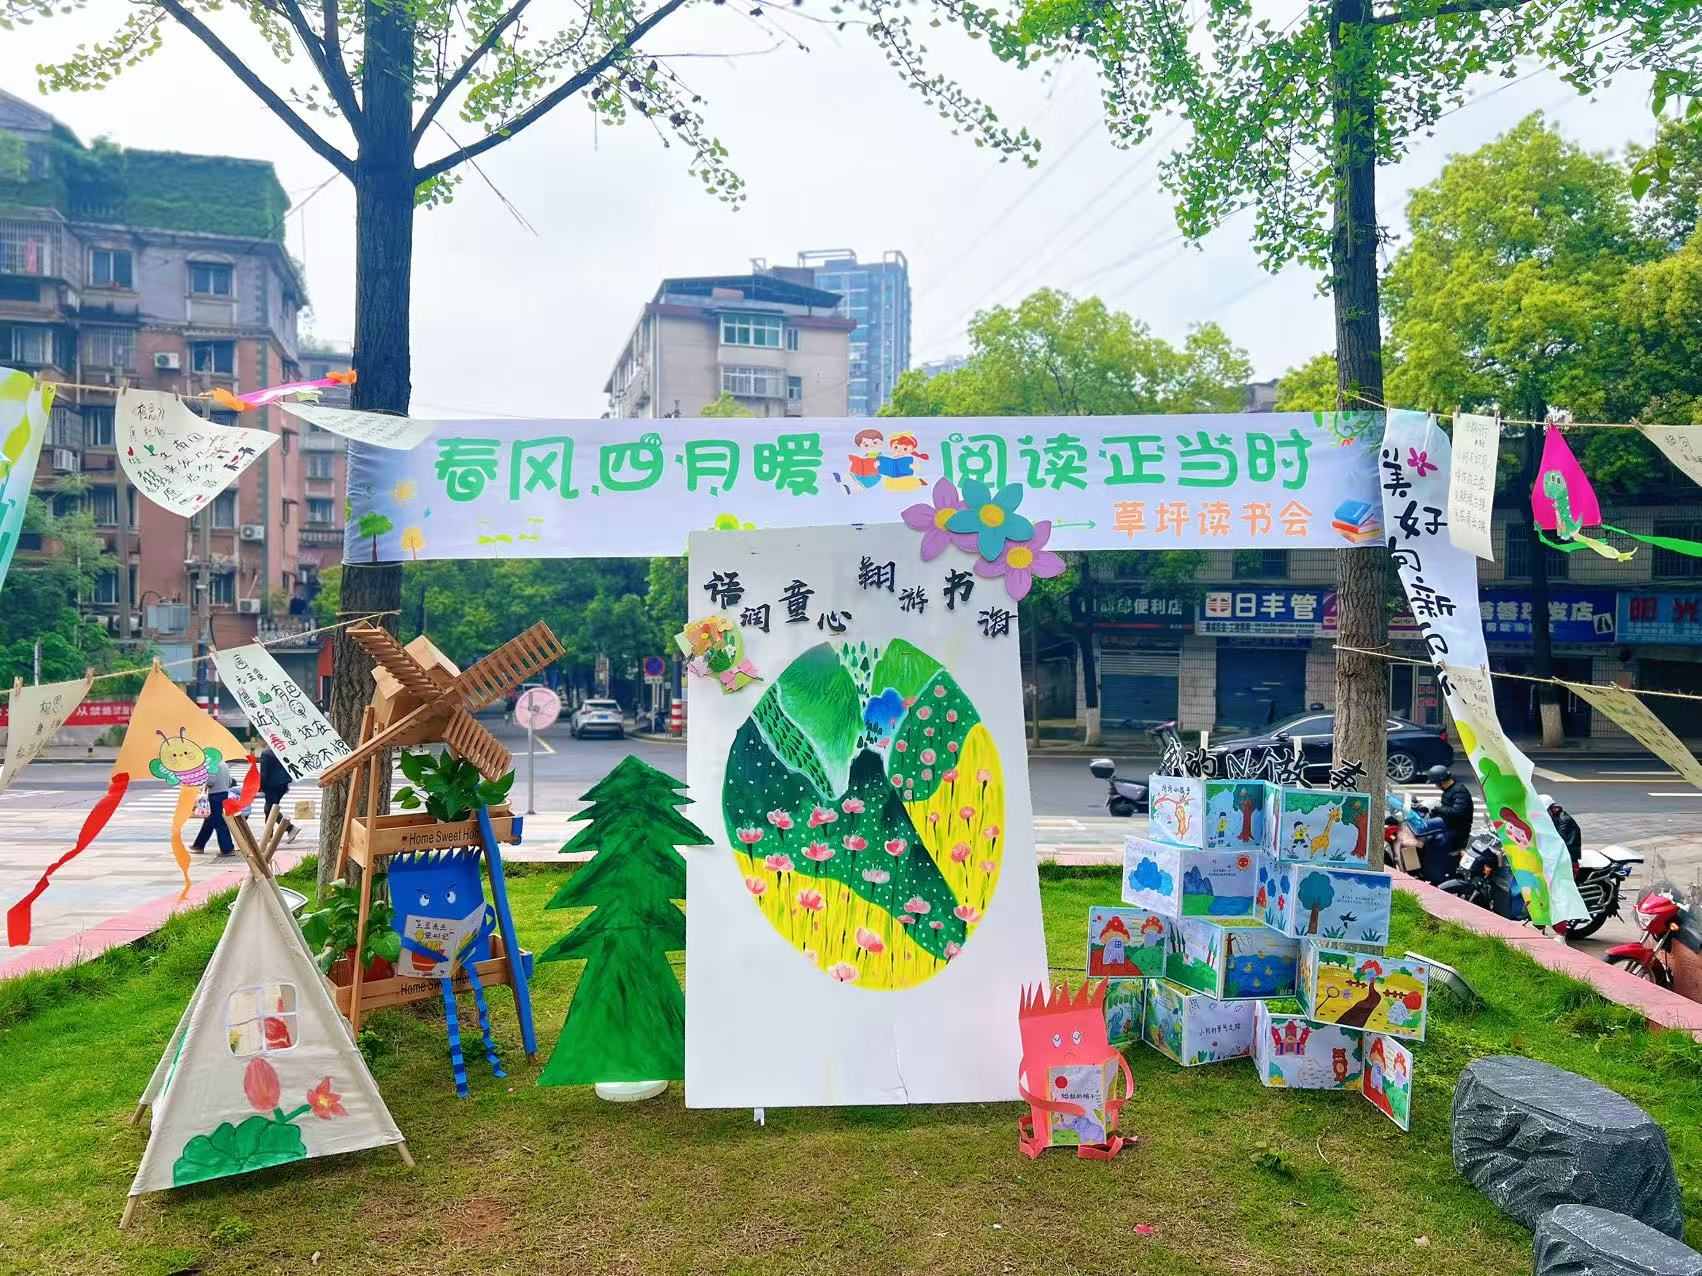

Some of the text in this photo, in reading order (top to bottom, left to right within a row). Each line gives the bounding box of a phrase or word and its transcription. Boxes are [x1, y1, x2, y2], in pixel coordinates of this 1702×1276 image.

[434, 429, 1312, 501] 春风四月暖 阅读正当时
[1112, 500, 1313, 537] 草坪读书会
[703, 556, 1018, 638] 语润童心 翔游书海
[1235, 593, 1318, 620] 日丰管
[408, 828, 481, 846] Home Sweet Hom
[400, 982, 426, 996] Home
